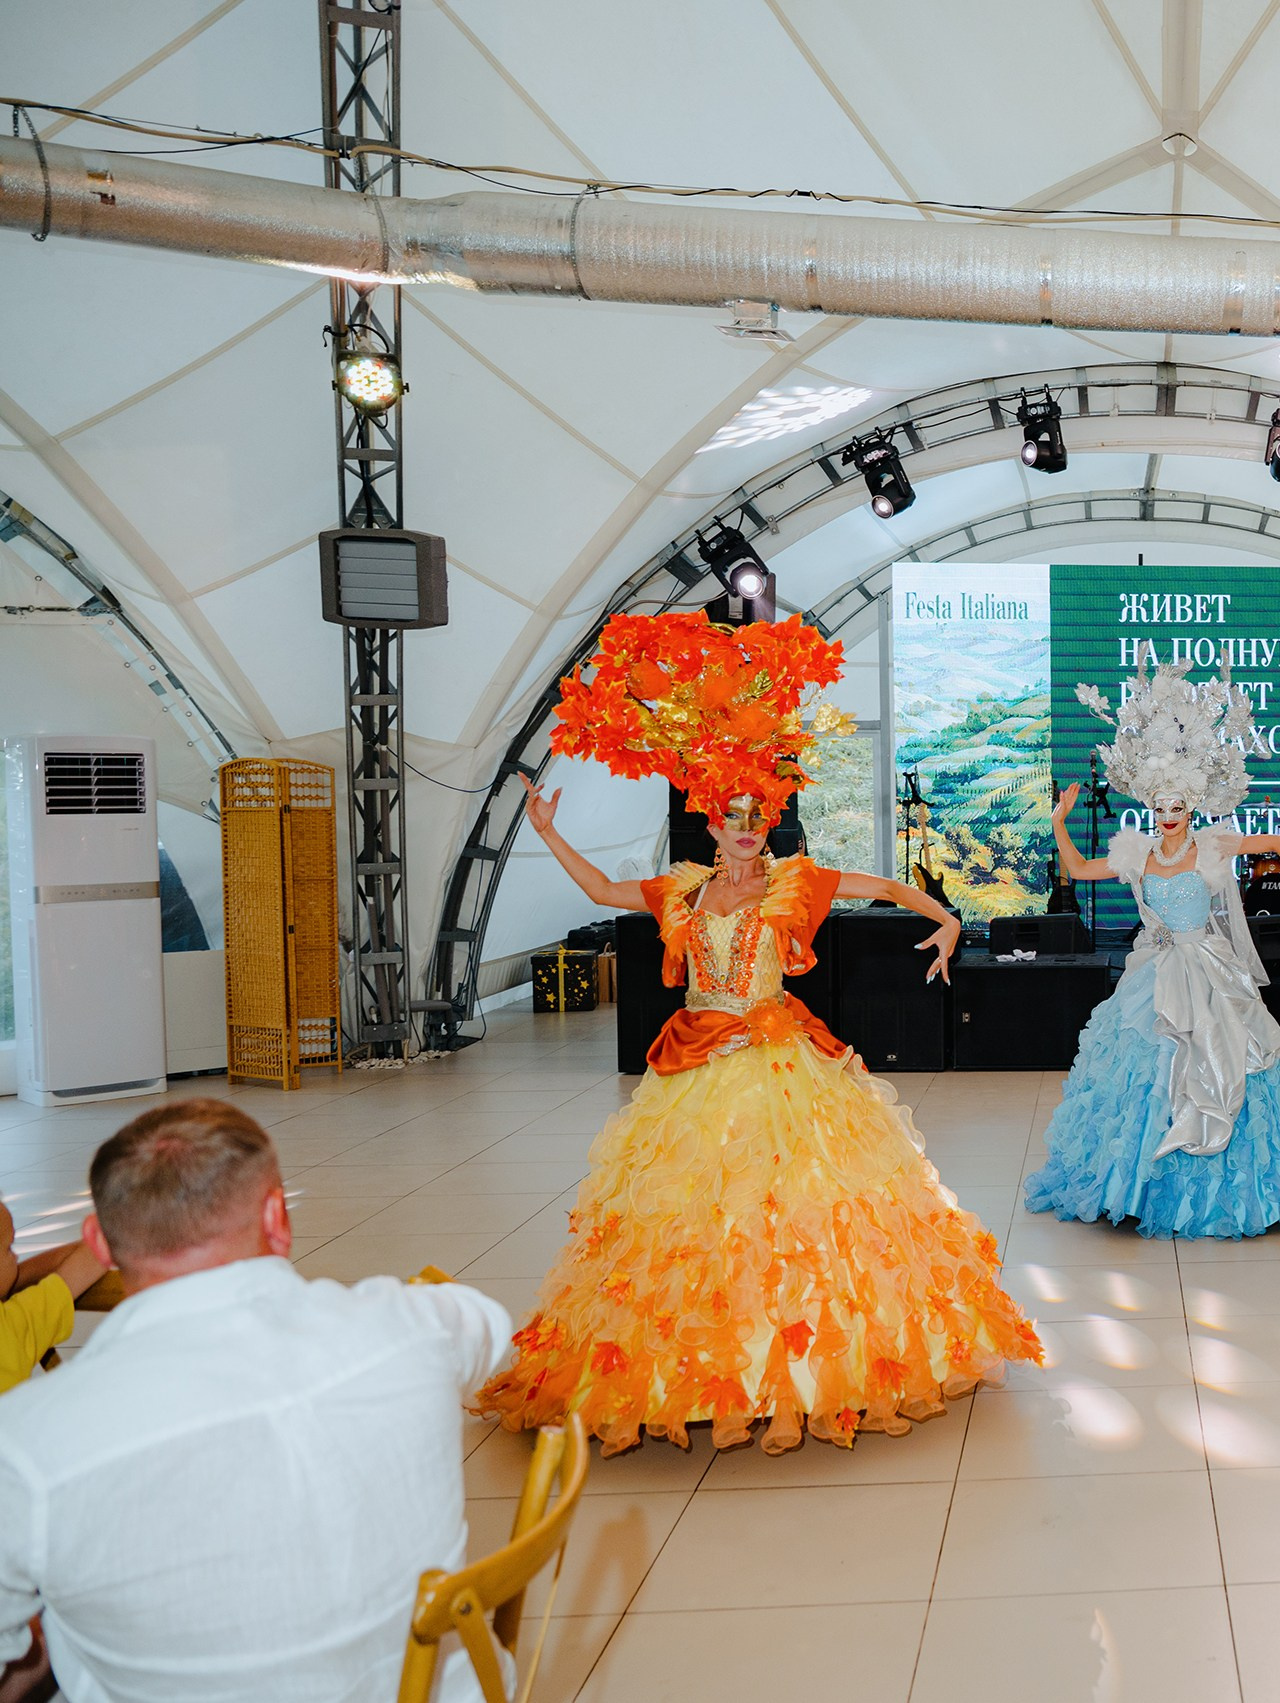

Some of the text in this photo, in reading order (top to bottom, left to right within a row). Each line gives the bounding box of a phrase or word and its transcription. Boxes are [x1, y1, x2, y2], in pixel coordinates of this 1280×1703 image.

[905, 592, 1029, 620] Festa Italiana
[1118, 593, 1231, 623] ЖИВЕТ
[1118, 638, 1160, 667] НА
